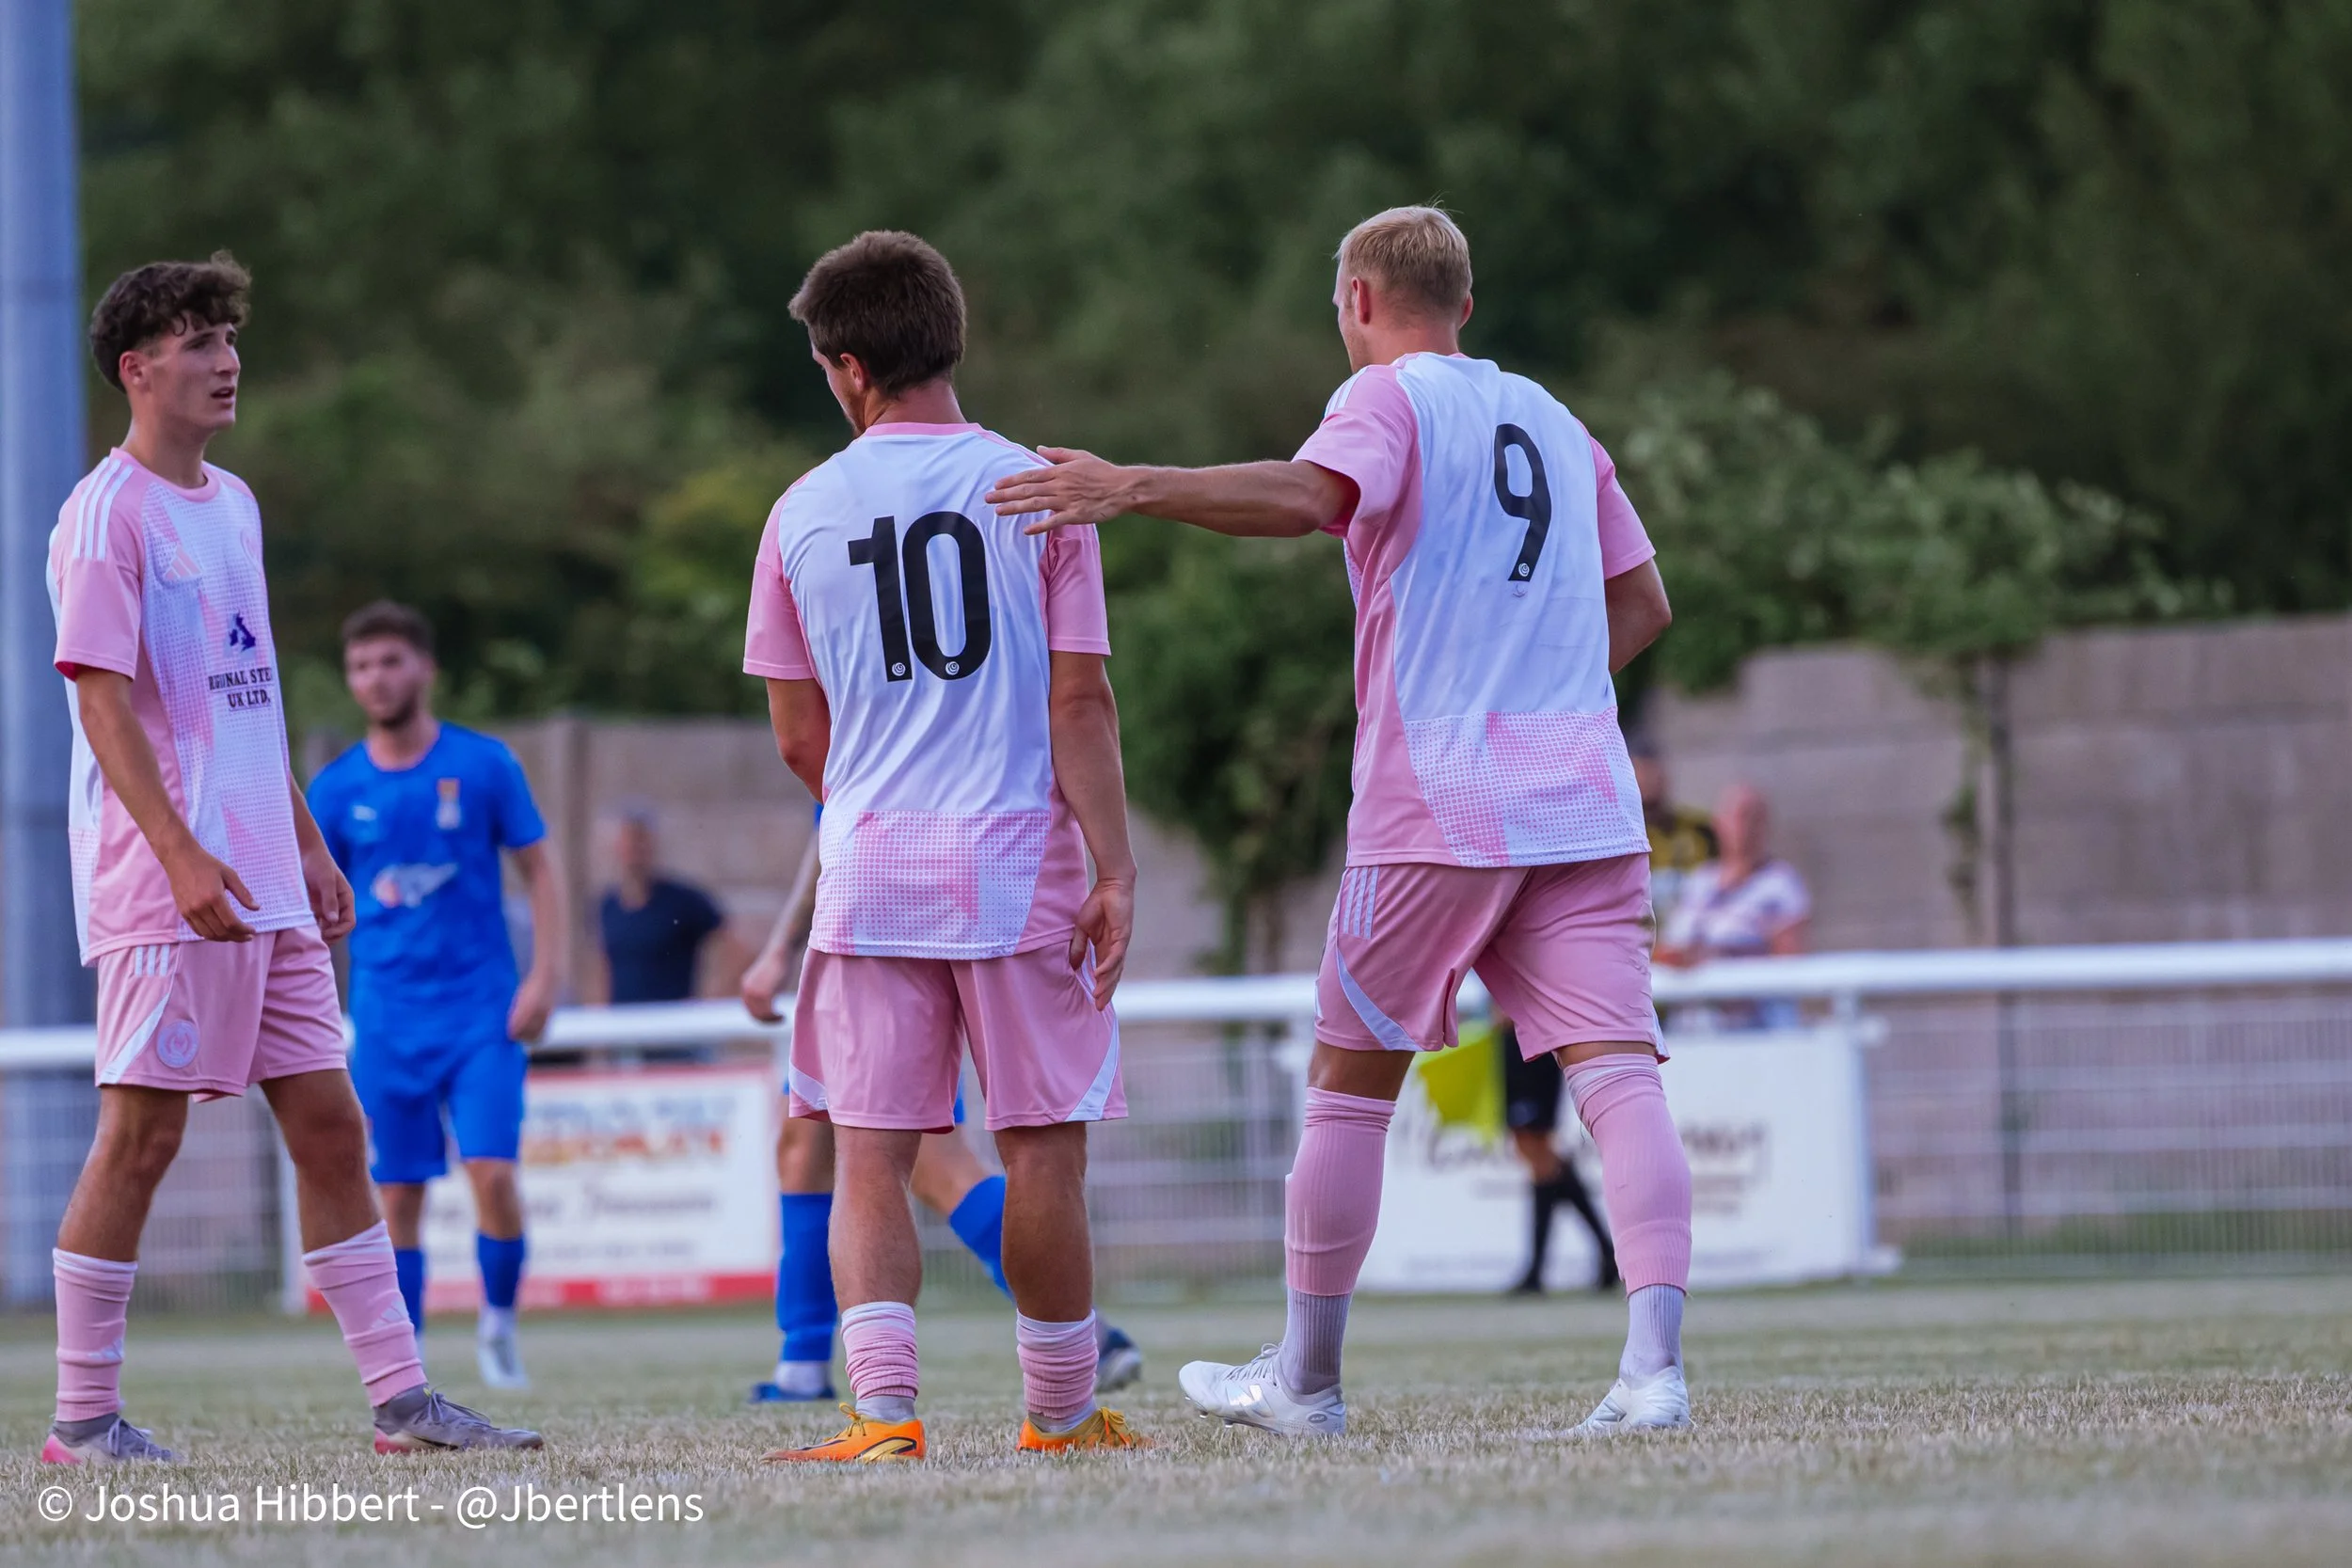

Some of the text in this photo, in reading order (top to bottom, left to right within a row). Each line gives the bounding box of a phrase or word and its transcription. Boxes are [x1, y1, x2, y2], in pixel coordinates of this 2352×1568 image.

[1494, 423, 1551, 581] 9
[848, 511, 992, 683] 10
[227, 692, 244, 707] UK
